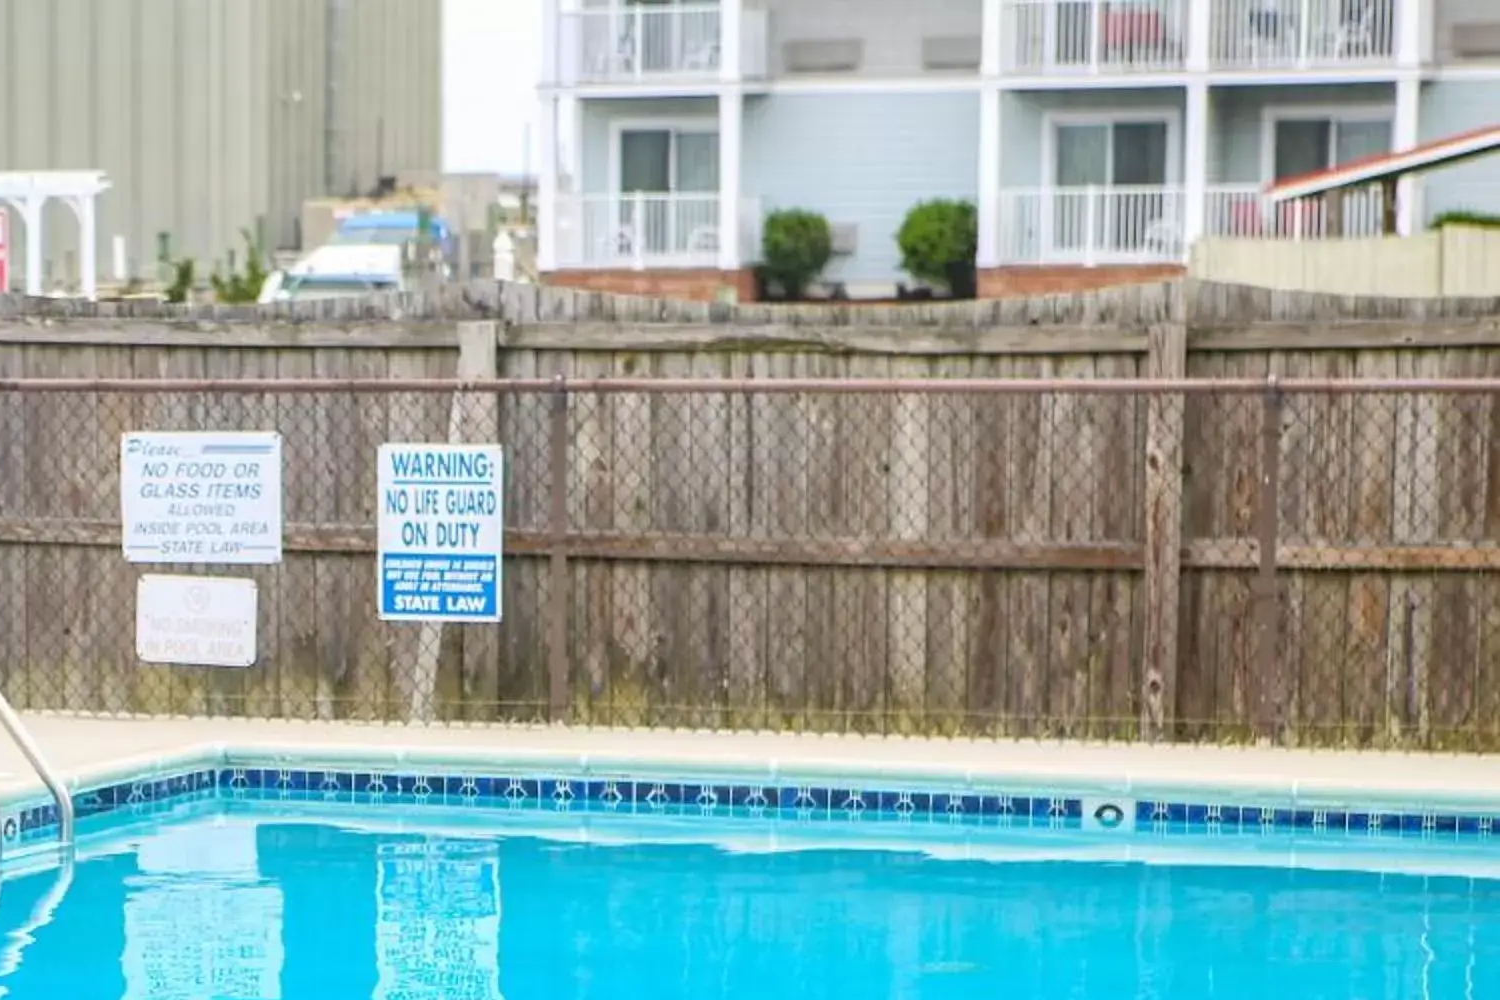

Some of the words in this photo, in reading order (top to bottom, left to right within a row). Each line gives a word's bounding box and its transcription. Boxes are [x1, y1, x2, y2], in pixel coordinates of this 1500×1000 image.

[141, 462, 170, 479] NO
[175, 462, 227, 479] FOOD
[233, 462, 261, 479] OR
[391, 452, 495, 479] WARNING:
[139, 482, 200, 500] GLASS
[205, 482, 263, 500] ITEMS
[167, 502, 236, 517] ALLOWED
[385, 489, 409, 515] NO
[415, 489, 440, 515] LIFE
[445, 489, 497, 516] GUARD
[133, 521, 182, 535] INSIDE
[185, 521, 223, 535] POOL
[229, 521, 270, 535] AREA
[400, 520, 429, 547] ON
[436, 521, 481, 548] DUTY
[159, 540, 205, 556] STATE
[210, 541, 244, 555] LAW
[392, 593, 441, 612] STATE
[445, 594, 488, 613] LAW
